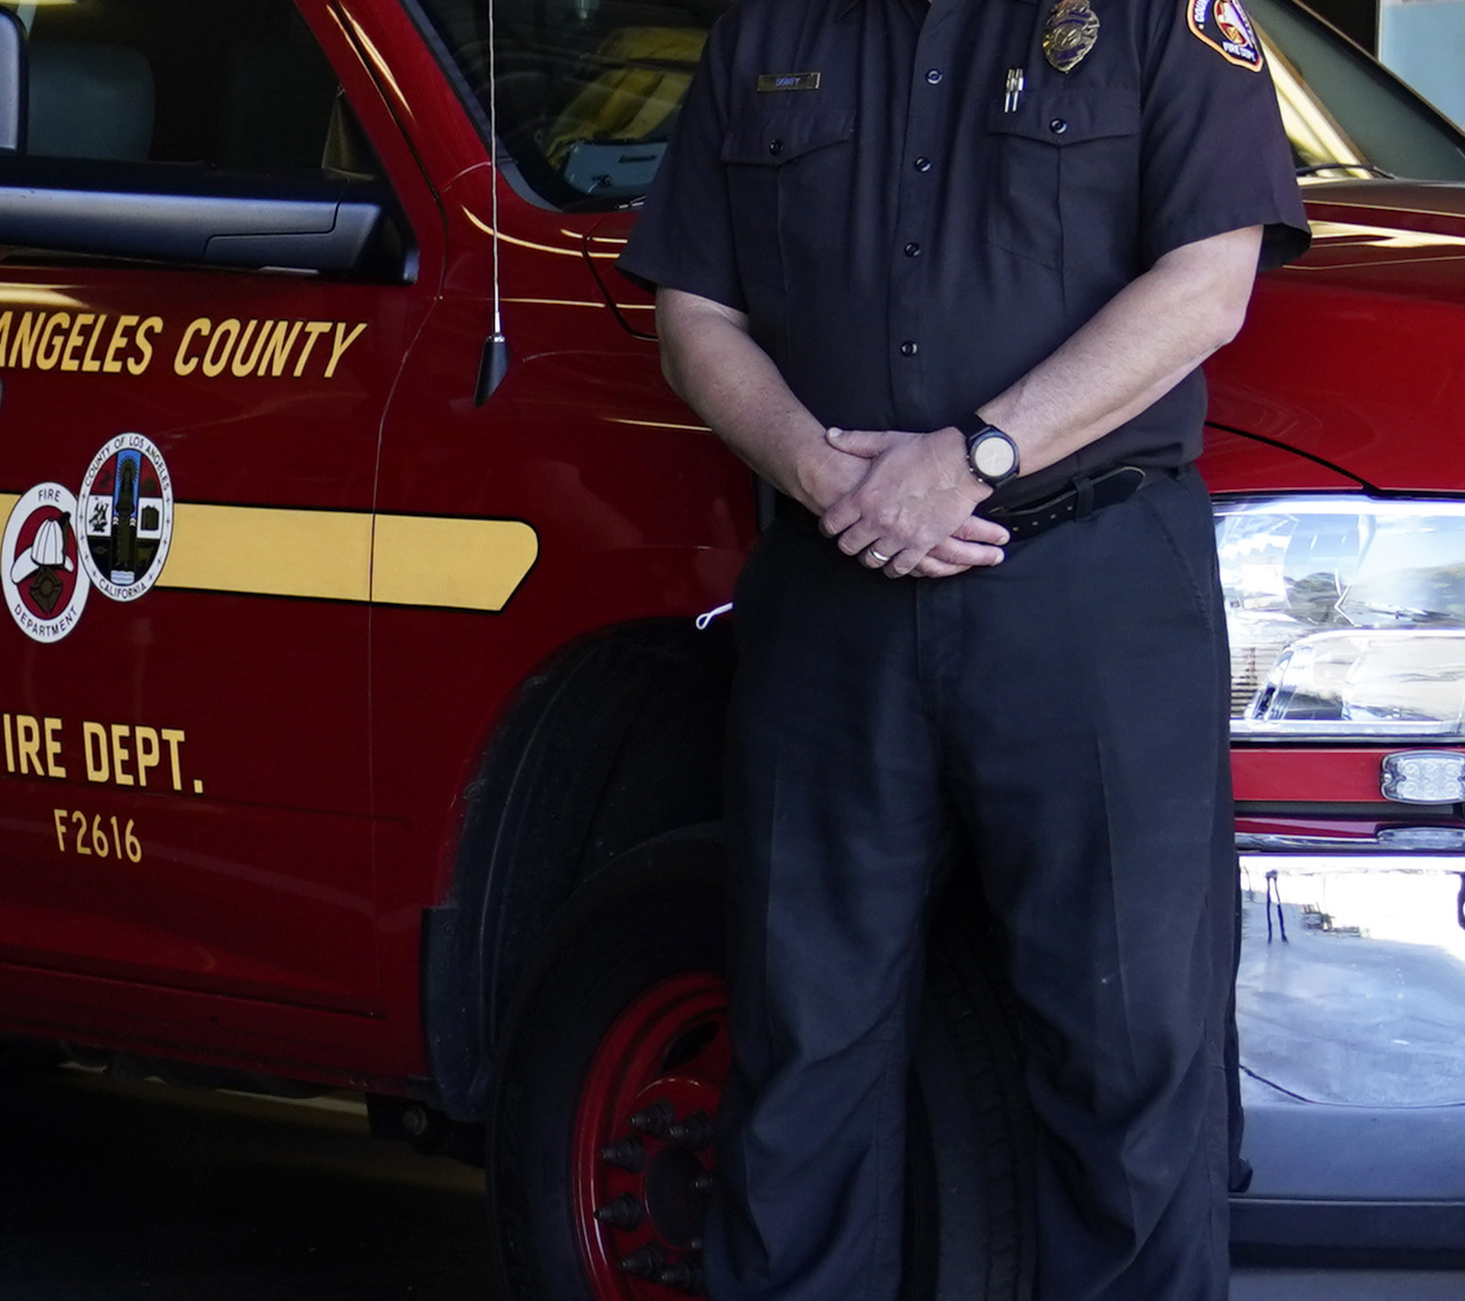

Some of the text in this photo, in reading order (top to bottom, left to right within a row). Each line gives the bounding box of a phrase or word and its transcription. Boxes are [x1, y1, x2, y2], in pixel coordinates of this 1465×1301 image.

[172, 316, 369, 379] COUNTY
[84, 436, 170, 492] COUNTY OF LOS ANGELES
[38, 489, 62, 503] FIRE
[98, 578, 147, 600] CALIFORNIA
[14, 603, 78, 638] DEPARTMENT
[82, 720, 205, 795] DEPT.
[53, 808, 144, 864] F2616
